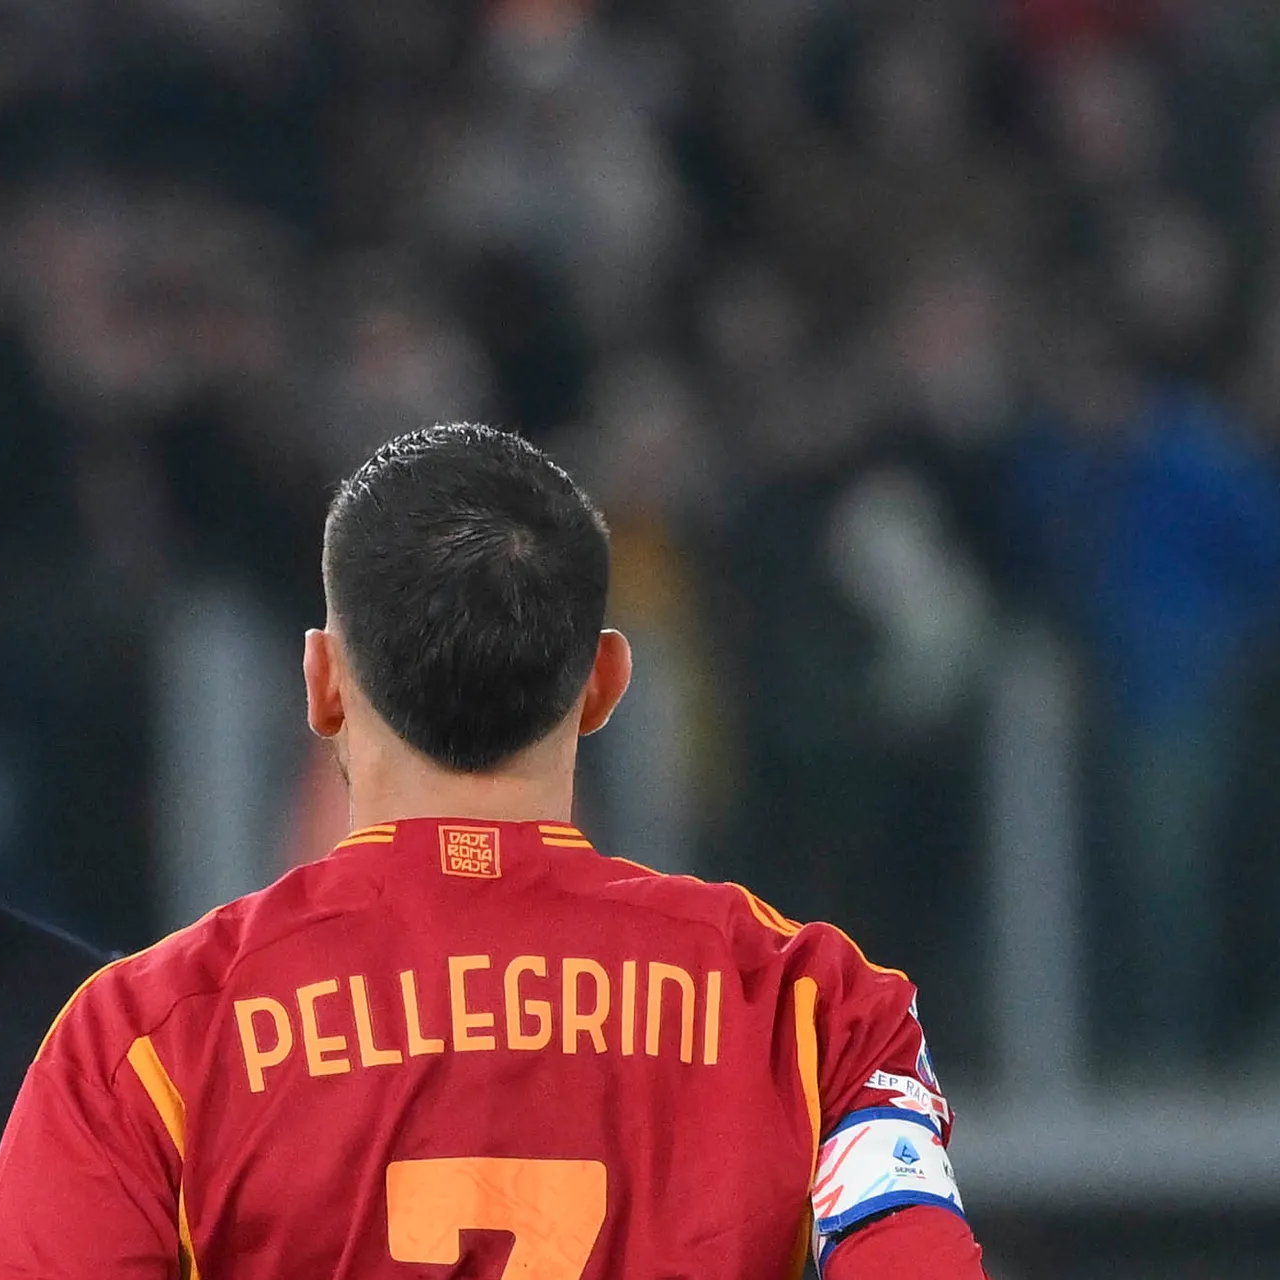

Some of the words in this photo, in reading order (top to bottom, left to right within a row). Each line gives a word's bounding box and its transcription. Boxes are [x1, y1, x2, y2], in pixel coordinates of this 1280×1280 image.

[449, 832, 489, 848] DAJE
[447, 844, 492, 862] ROMA
[451, 857, 491, 874] DAJE
[233, 954, 721, 1093] PELLEGRINI
